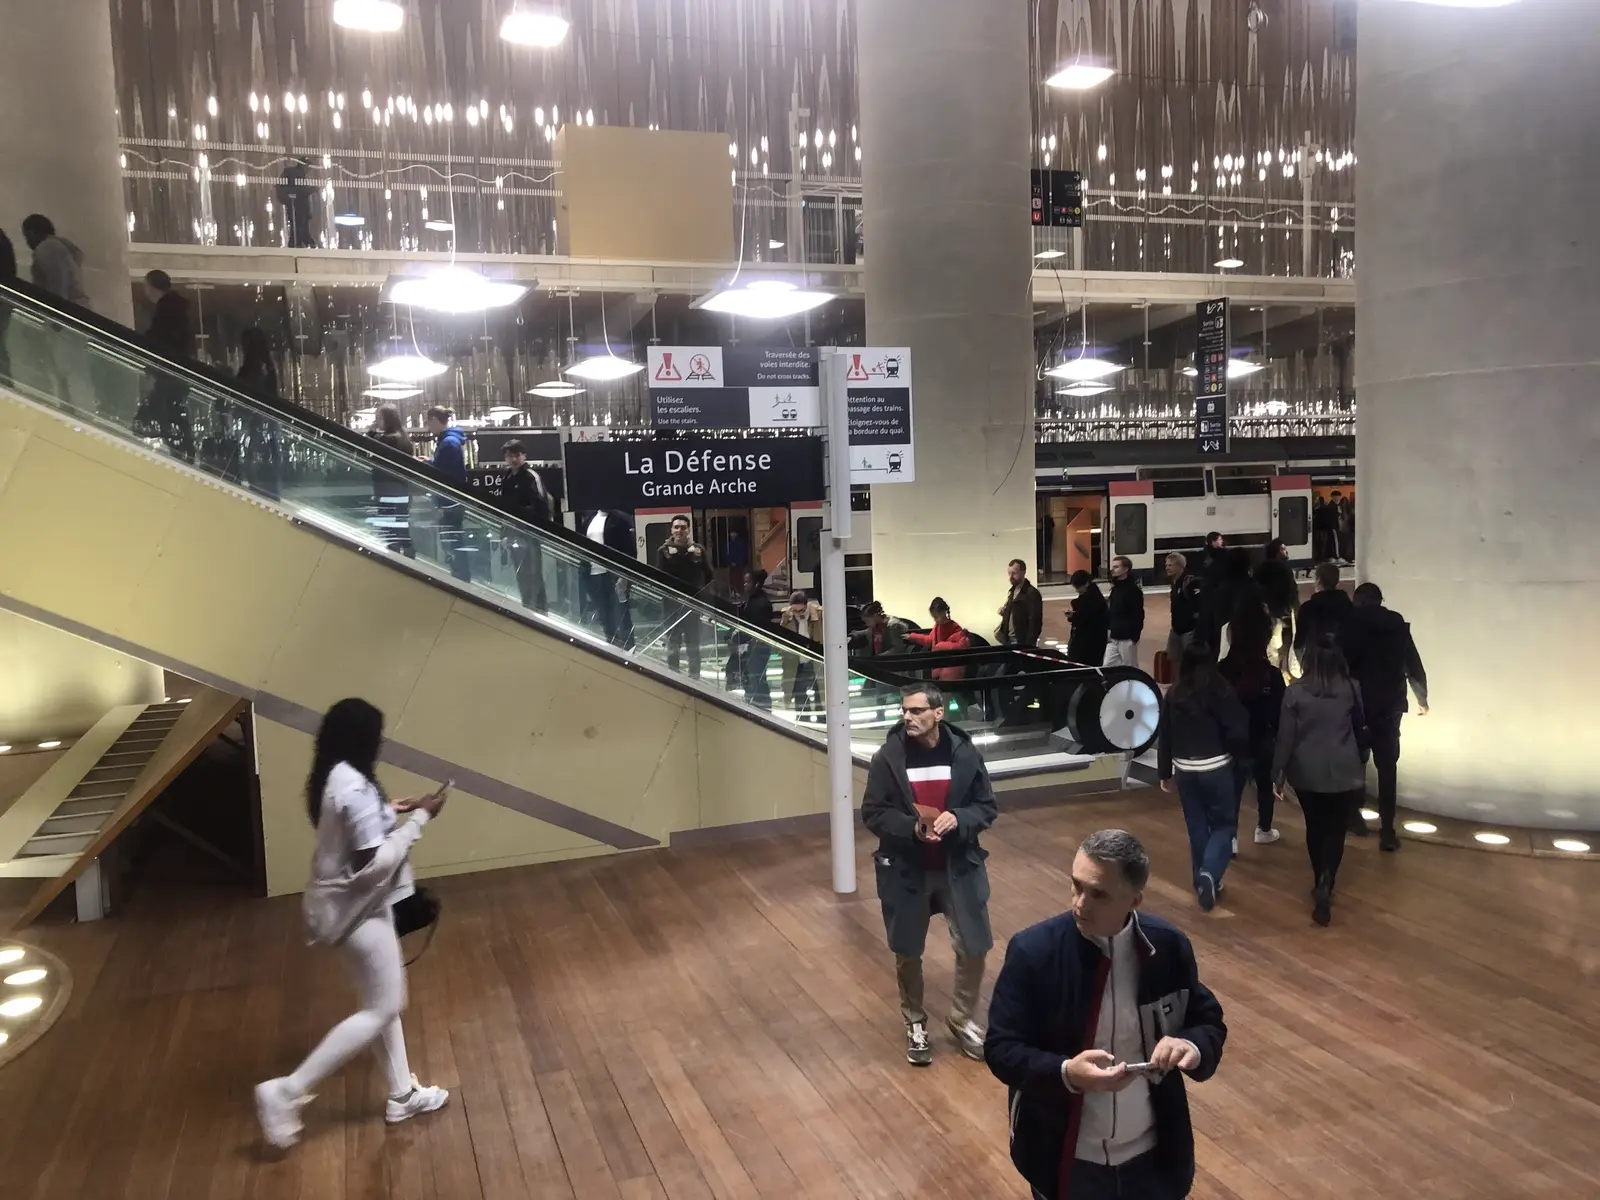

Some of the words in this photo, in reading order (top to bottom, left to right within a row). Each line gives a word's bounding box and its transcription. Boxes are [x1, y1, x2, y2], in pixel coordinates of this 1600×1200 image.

[764, 350, 797, 359] Traversée
[798, 351, 811, 359] des
[759, 360, 778, 368] voies
[779, 360, 811, 368] interdite.
[757, 372, 766, 380] Do
[656, 395, 684, 404] Utilisez
[657, 405, 668, 414] les
[669, 405, 702, 414] escaliers.
[884, 404, 904, 412] trains.
[681, 417, 699, 425] stairs.
[853, 427, 879, 435] bordure
[879, 427, 888, 435] du
[889, 427, 905, 436] quai.
[624, 451, 654, 475] La
[665, 448, 772, 474] Défense
[642, 479, 704, 497] Grande
[708, 477, 757, 494] Arche
